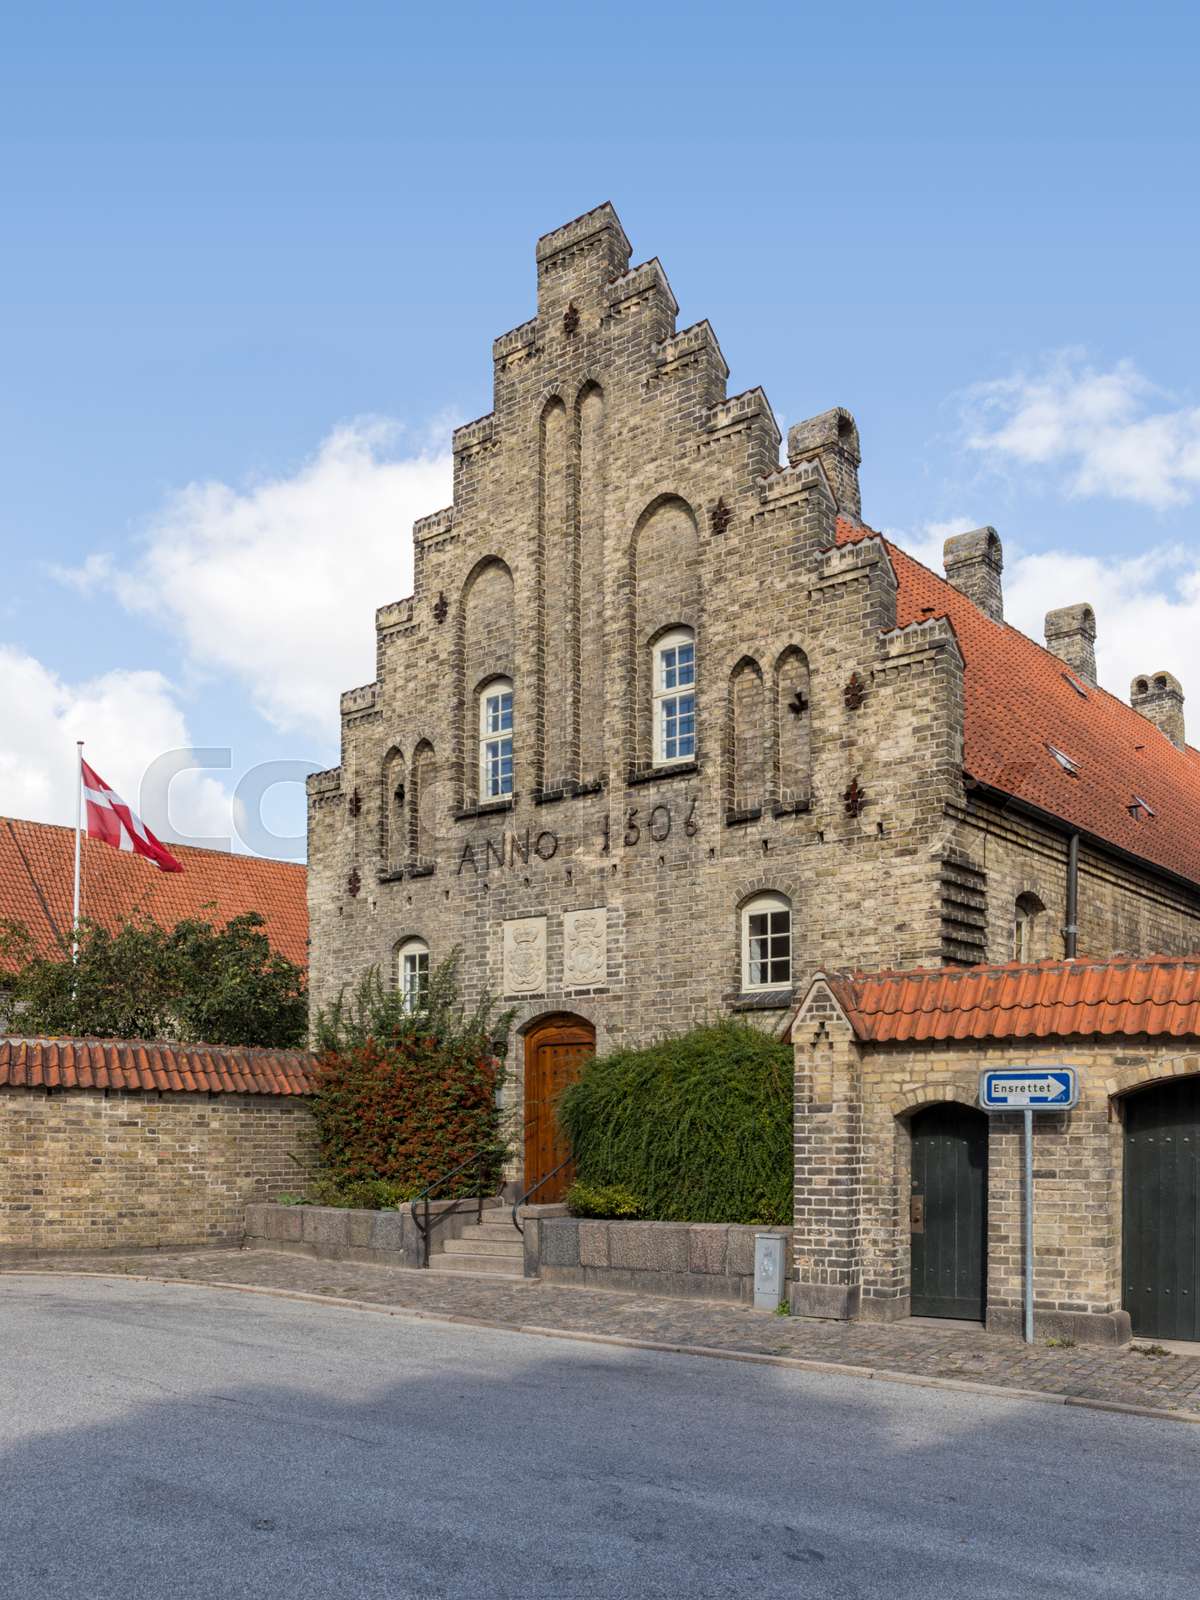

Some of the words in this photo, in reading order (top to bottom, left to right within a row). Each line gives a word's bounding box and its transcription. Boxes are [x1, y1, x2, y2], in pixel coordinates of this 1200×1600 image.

[457, 828, 559, 875] ANNO
[601, 796, 698, 852] 1506
[993, 1083, 1052, 1093] Ensrettet
